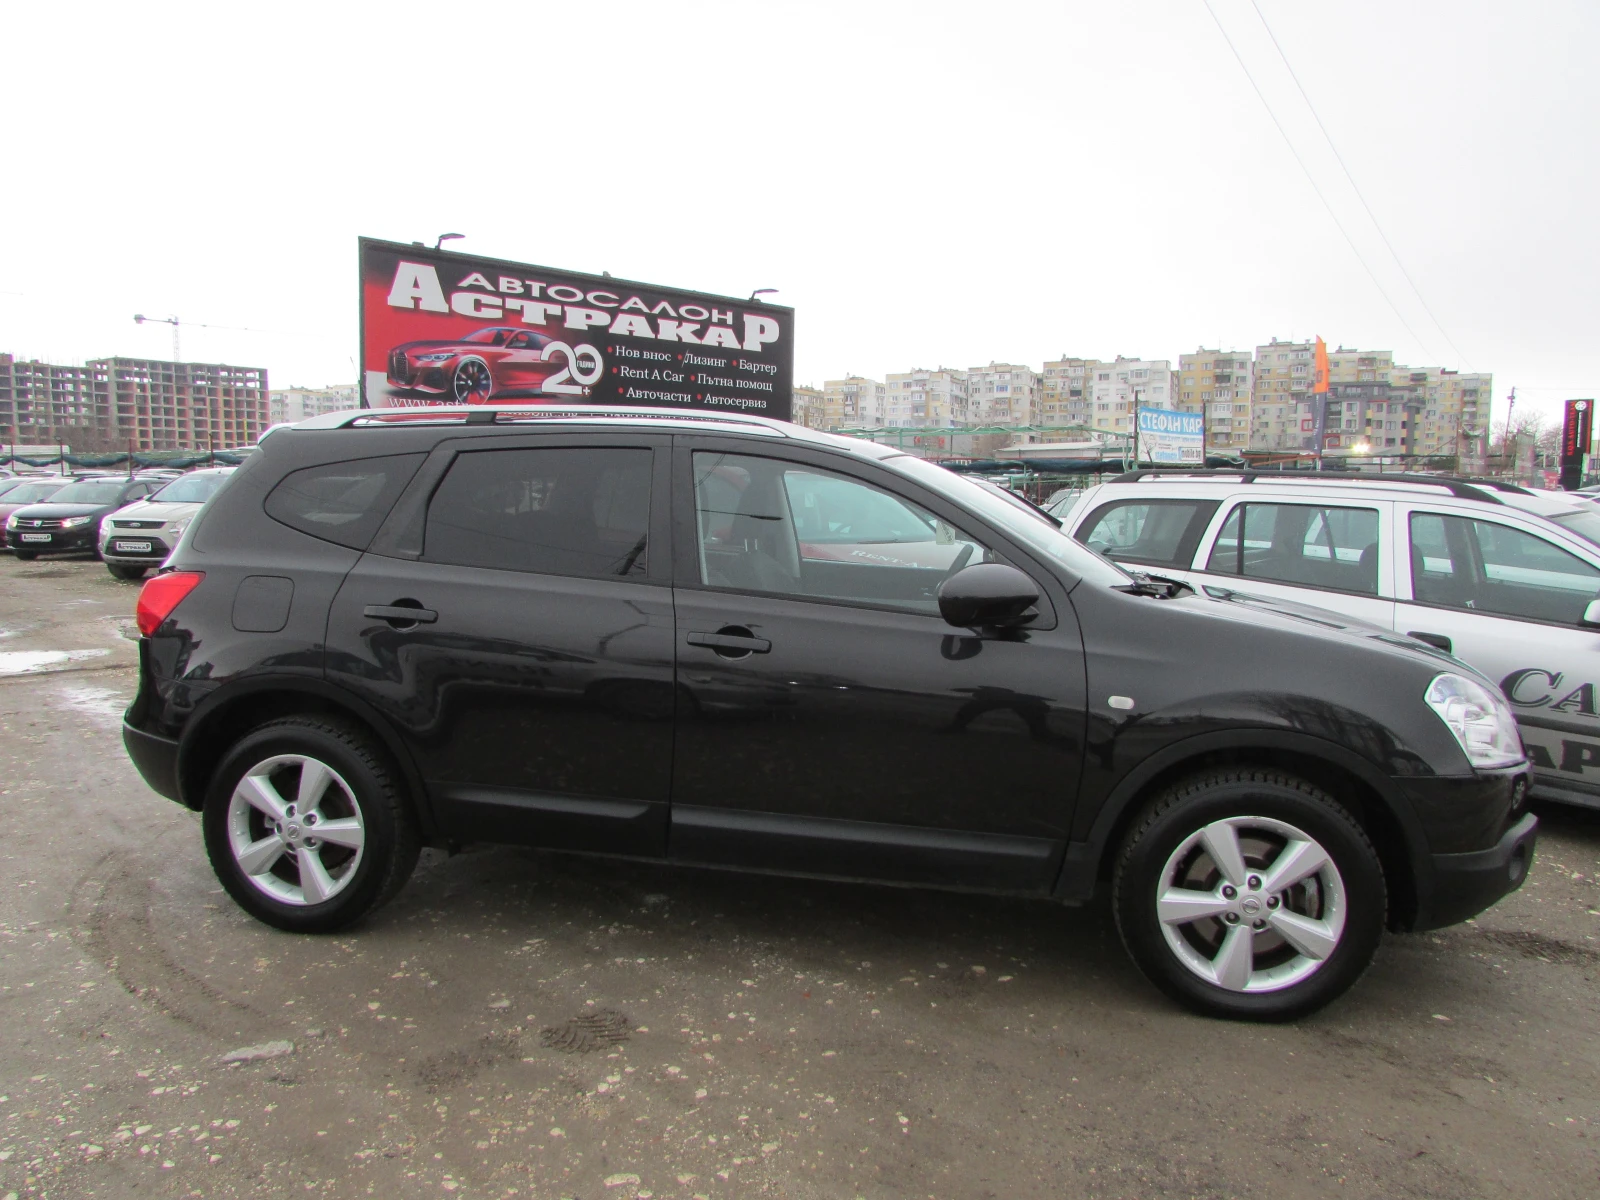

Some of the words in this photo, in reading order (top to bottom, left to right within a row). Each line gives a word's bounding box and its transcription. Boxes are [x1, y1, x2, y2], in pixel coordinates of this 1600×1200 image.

[387, 261, 780, 352] АСТРАКАР
[457, 272, 734, 325] АВТОСАЛОН
[615, 346, 640, 358] Нов
[643, 351, 672, 361] внос
[684, 353, 727, 367] Лизинг
[739, 359, 777, 374] Бартер
[620, 366, 649, 379] Rent
[651, 369, 661, 380] A
[663, 370, 685, 383] Car
[697, 374, 733, 387] Пътна
[736, 380, 773, 392] помощ
[626, 387, 692, 402] Авточасти
[704, 393, 767, 409] Автосервиз
[1140, 412, 1181, 431] СТЕФАН
[1183, 416, 1203, 433] КАР
[1499, 668, 1600, 718] CA
